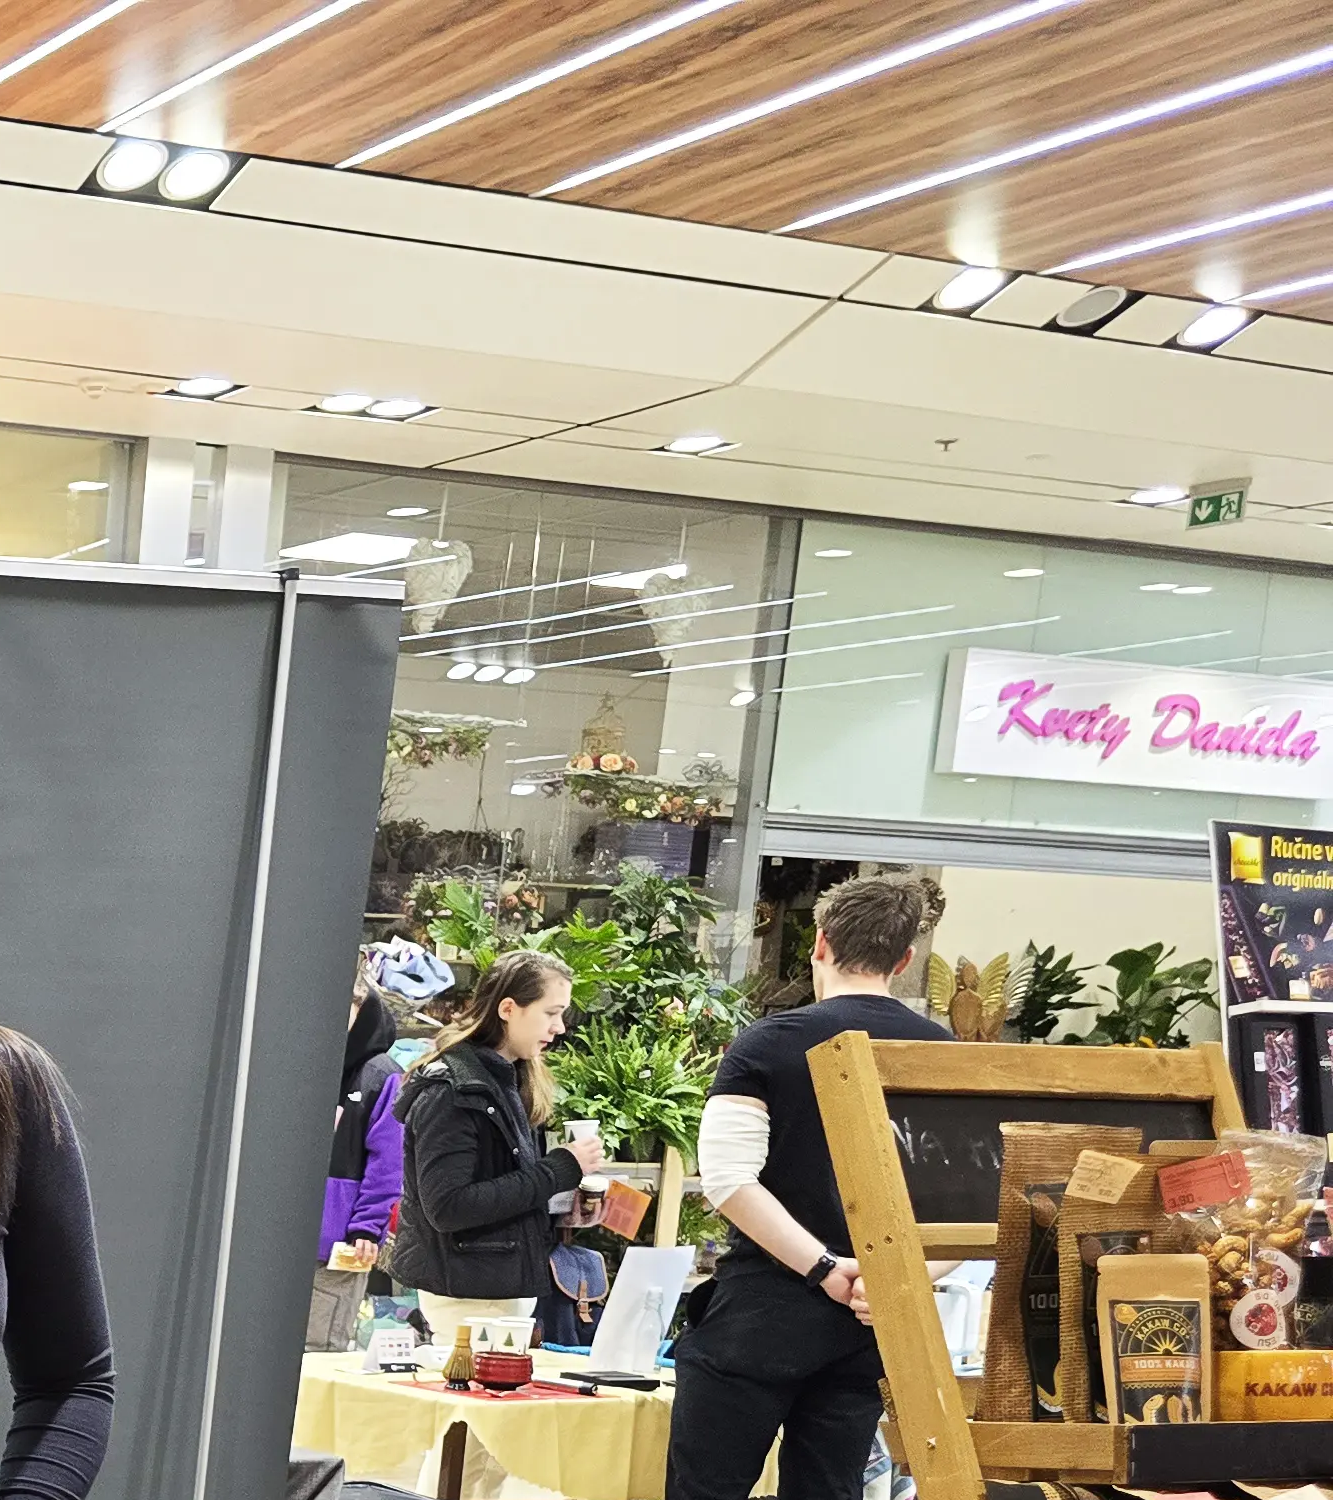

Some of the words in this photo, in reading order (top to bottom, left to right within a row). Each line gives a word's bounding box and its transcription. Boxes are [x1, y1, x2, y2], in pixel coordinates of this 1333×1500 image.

[997, 679, 1131, 760] Kvety
[1150, 693, 1321, 763] Daniela
[1271, 835, 1323, 862] Ručne
[1135, 1315, 1170, 1341] KAKAW
[1134, 1358, 1162, 1369] 100%
[1245, 1382, 1318, 1398] KAKAW
